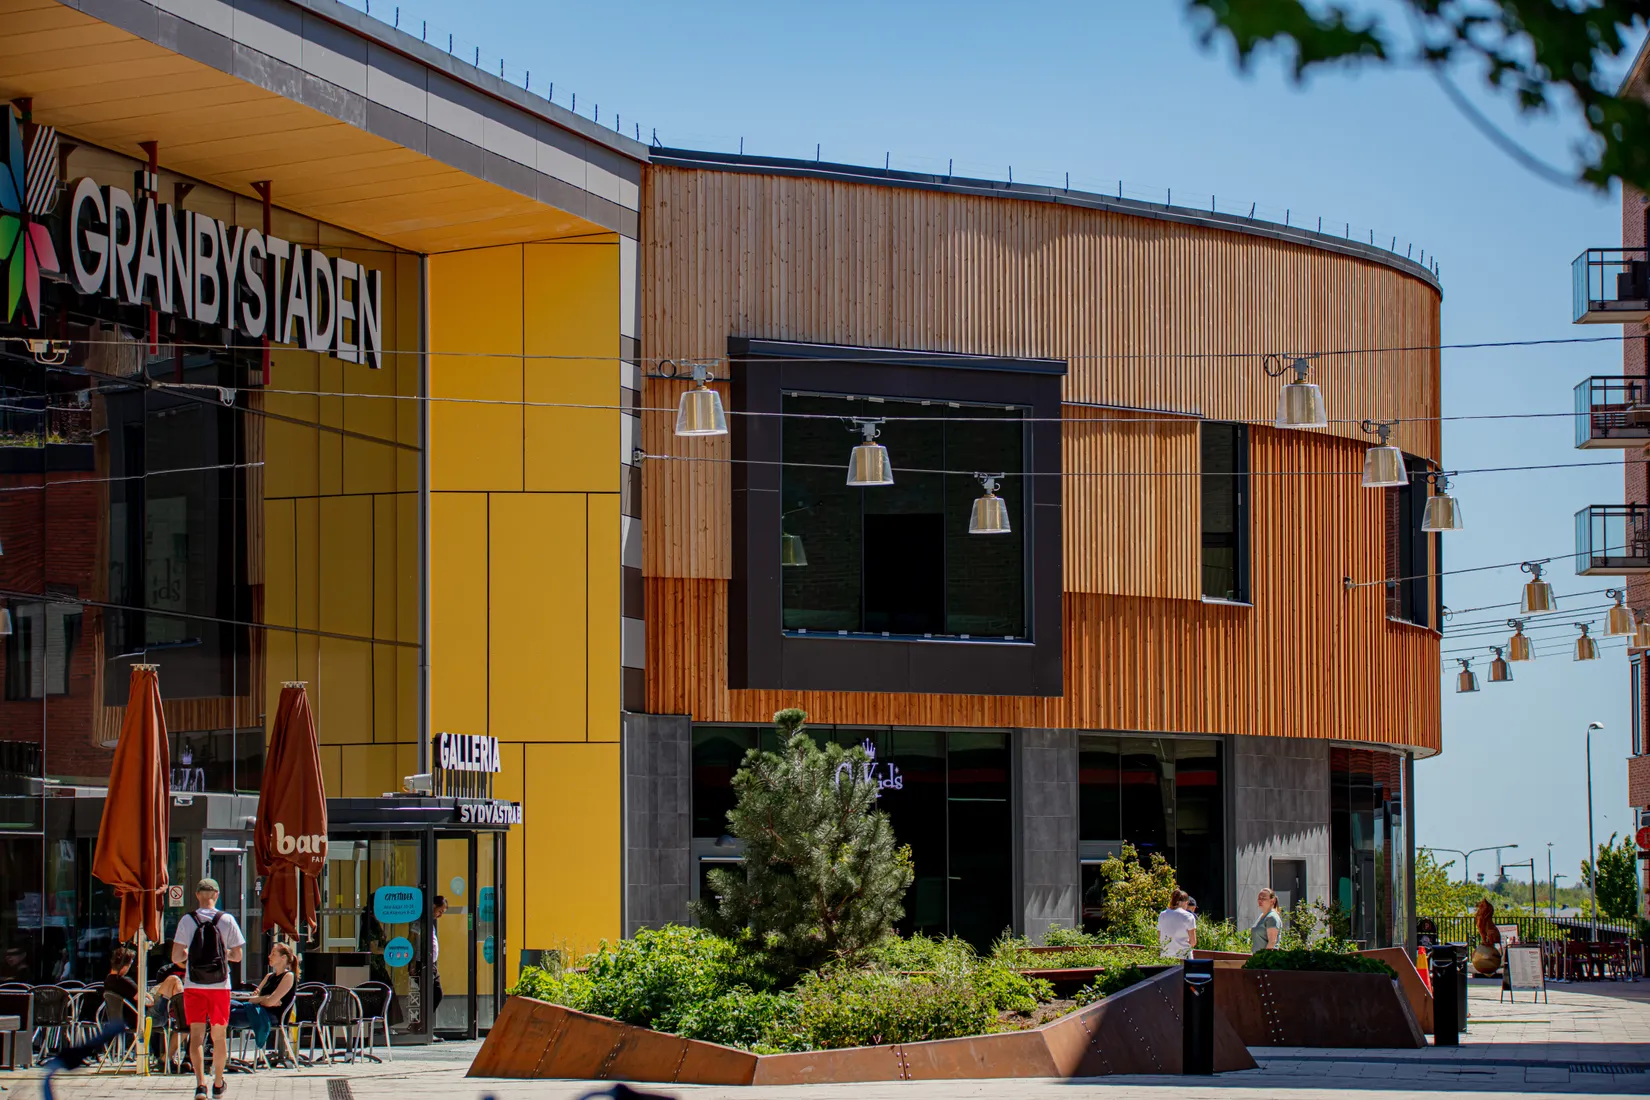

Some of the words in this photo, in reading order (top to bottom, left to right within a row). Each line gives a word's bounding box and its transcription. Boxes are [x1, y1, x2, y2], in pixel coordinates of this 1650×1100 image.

[70, 172, 382, 369] GRÄNBYSTADEN
[439, 731, 502, 773] GALLERIA
[274, 822, 328, 855] bar
